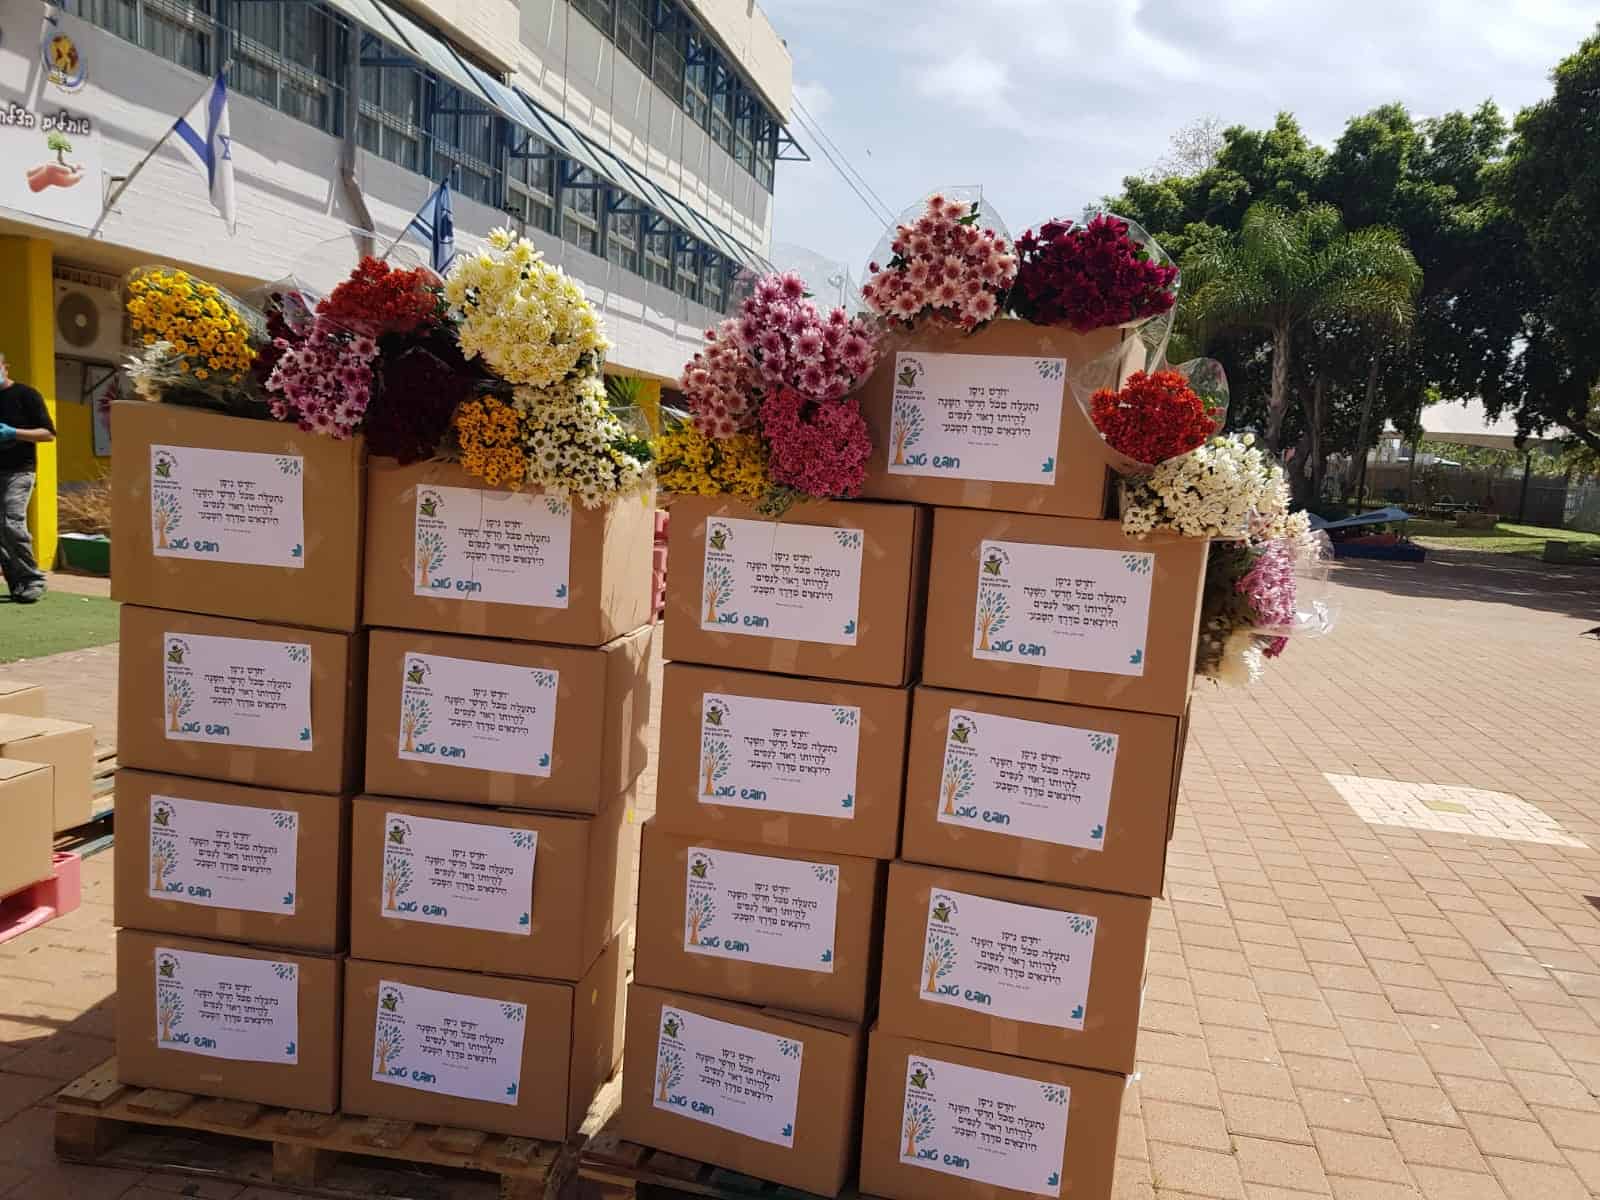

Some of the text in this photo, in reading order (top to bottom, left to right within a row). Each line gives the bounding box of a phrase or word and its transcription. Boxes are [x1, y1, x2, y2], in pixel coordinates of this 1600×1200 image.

[41, 110, 90, 134] שותלים
[905, 451, 960, 468] חודש טוב
[169, 536, 218, 552] חודש טוב
[431, 575, 481, 592] חודש טוב
[718, 610, 768, 627] חודש טוב
[991, 637, 1046, 656] חודש טוב
[181, 719, 228, 735] חודש טוב
[415, 740, 465, 758] חודש טוב
[715, 783, 766, 801] חודש טוב
[955, 803, 1010, 825] חודש טוב
[165, 880, 211, 897] חודש טוב
[398, 899, 446, 917] חודש טוב
[700, 934, 749, 952] חודש טוב
[938, 981, 991, 1004] חודש טוב
[172, 1031, 216, 1048] חודש טוב
[388, 1064, 407, 1077] טוב
[669, 1091, 714, 1116] חודש טוב
[917, 1145, 969, 1169] חודש טוב
